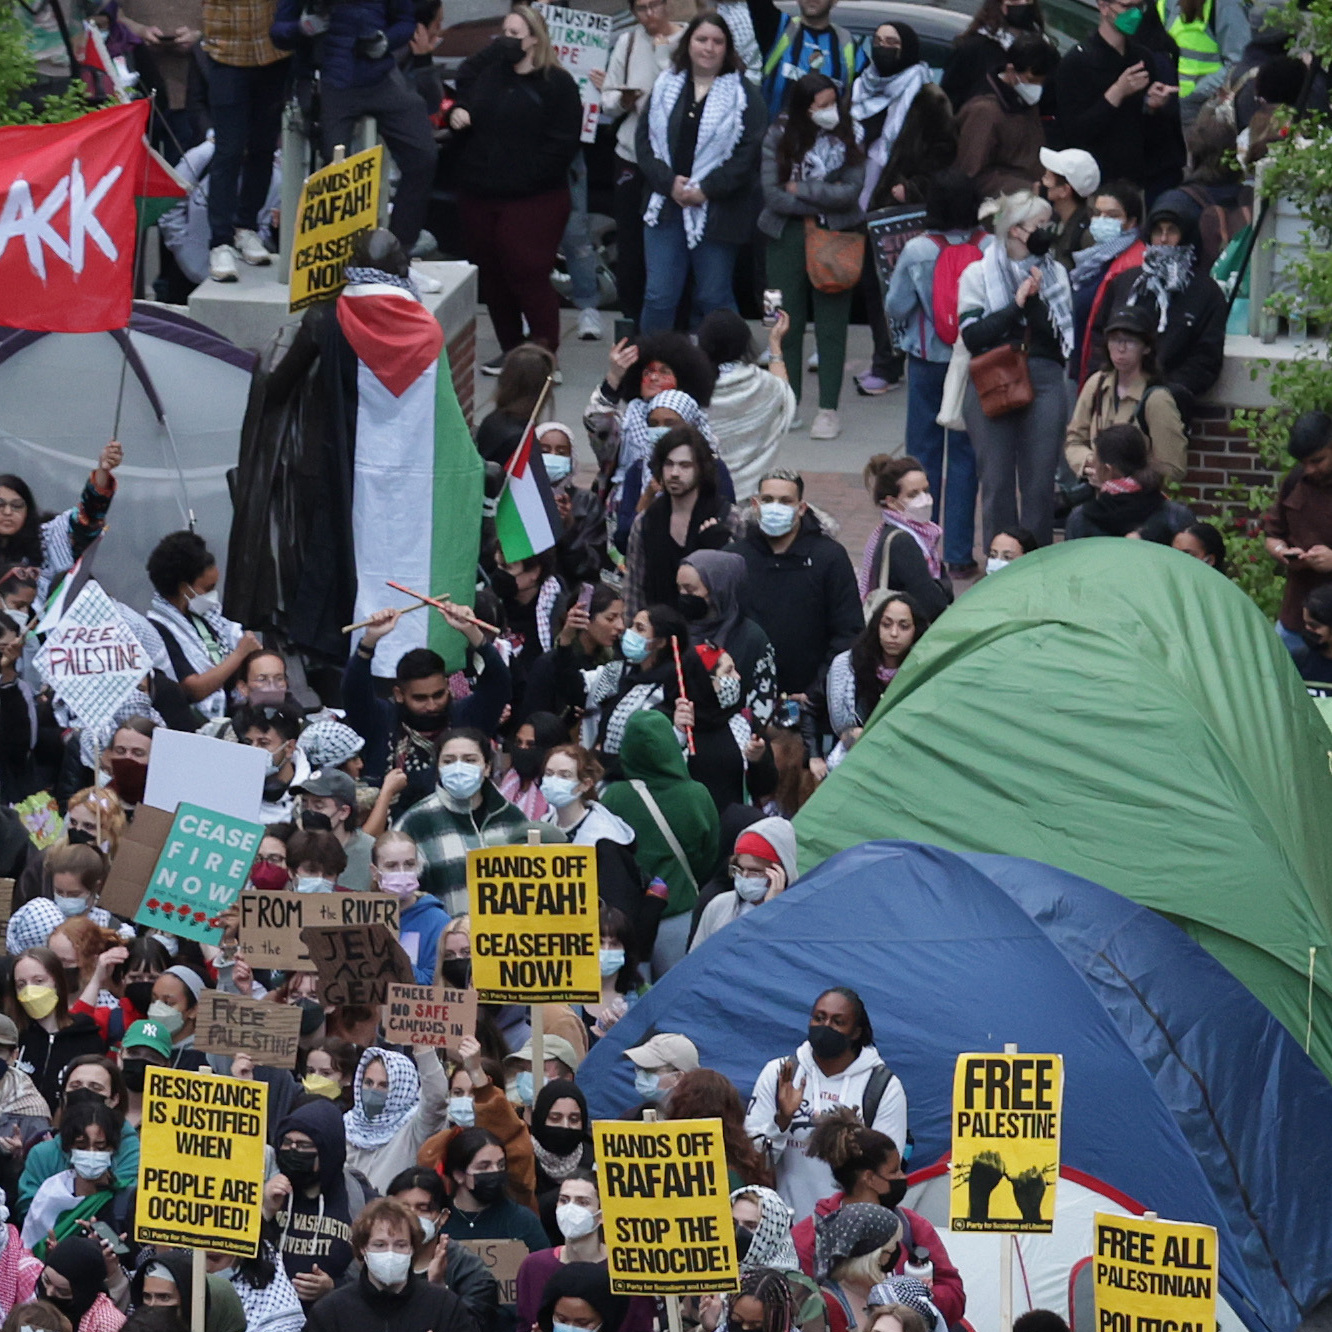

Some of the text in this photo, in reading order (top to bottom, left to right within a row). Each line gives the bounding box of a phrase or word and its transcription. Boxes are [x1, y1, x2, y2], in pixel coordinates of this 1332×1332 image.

[301, 182, 372, 235] RAFAH!
[60, 626, 116, 644] FREE
[48, 643, 142, 676] PALESTINE
[179, 814, 257, 853] CEASE
[167, 840, 246, 879] FIRE
[476, 855, 587, 879] HANDS OFF
[156, 867, 235, 906] NOW
[477, 881, 587, 916] RAFAH!
[241, 896, 303, 930] FROM
[319, 906, 337, 921] the
[341, 899, 400, 931] RIVER
[242, 942, 281, 956] to the
[476, 933, 595, 957] CEASEFIRE
[498, 959, 573, 988] NOW!
[391, 986, 434, 1002] THERE
[443, 989, 465, 1004] ARE
[211, 997, 266, 1027] FREE
[389, 1018, 463, 1036] CAMPUSES IN
[390, 1003, 449, 1021] NO SAFE
[207, 1024, 298, 1057] PALESTINE
[410, 1033, 447, 1046] GAZA
[149, 1073, 262, 1112] RESISTANCE
[964, 1059, 1053, 1112] FREE
[148, 1101, 260, 1137] IS JUSTIFIED
[957, 1111, 1056, 1139] PALESTINE
[176, 1132, 232, 1160] WHEN
[602, 1131, 714, 1159] HANDS OFF
[143, 1166, 257, 1206] PEOPLE ARE
[605, 1160, 717, 1199] RAFAH!
[148, 1196, 250, 1233] OCCUPIED!
[616, 1216, 719, 1244] STOP THE
[611, 1246, 731, 1274] GENOCIDE!
[1097, 1225, 1212, 1271] FREE ALL
[1097, 1264, 1211, 1300] PALESTINIAN
